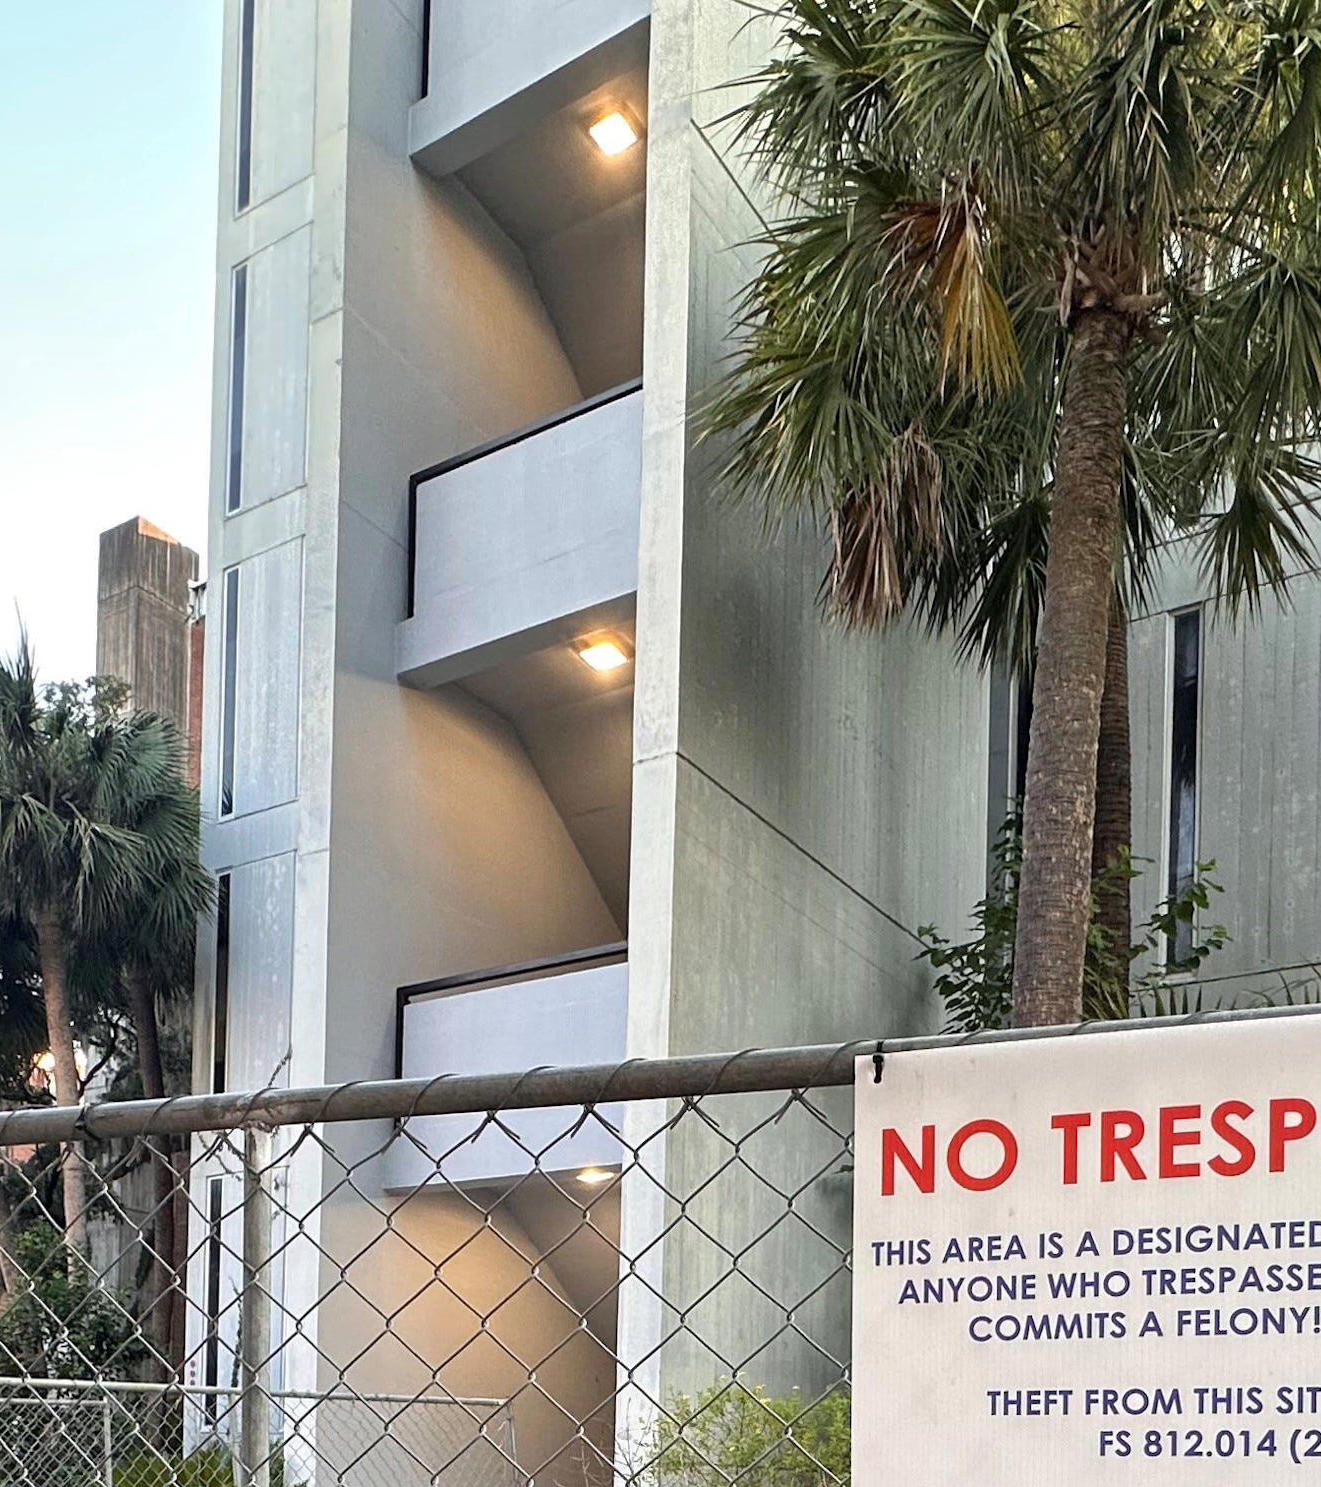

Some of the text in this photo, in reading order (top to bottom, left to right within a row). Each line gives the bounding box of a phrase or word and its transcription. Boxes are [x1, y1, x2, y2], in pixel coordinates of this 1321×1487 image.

[881, 1119, 1018, 1196] NO
[872, 1239, 931, 1266] THIS
[942, 1235, 1026, 1263] AREA
[1039, 1233, 1063, 1258] IS
[1076, 1231, 1099, 1257] A
[899, 1275, 1035, 1304] ANYONE
[1048, 1271, 1130, 1298] WHO
[969, 1312, 1126, 1342] COMMITS
[1139, 1311, 1163, 1337] A
[1178, 1306, 1320, 1336] FELONY!
[987, 1390, 1073, 1415] THEFT
[1086, 1389, 1182, 1415] FROM
[1194, 1387, 1263, 1414] THIS
[1100, 1431, 1131, 1456] FS
[1144, 1430, 1277, 1457] 812.014
